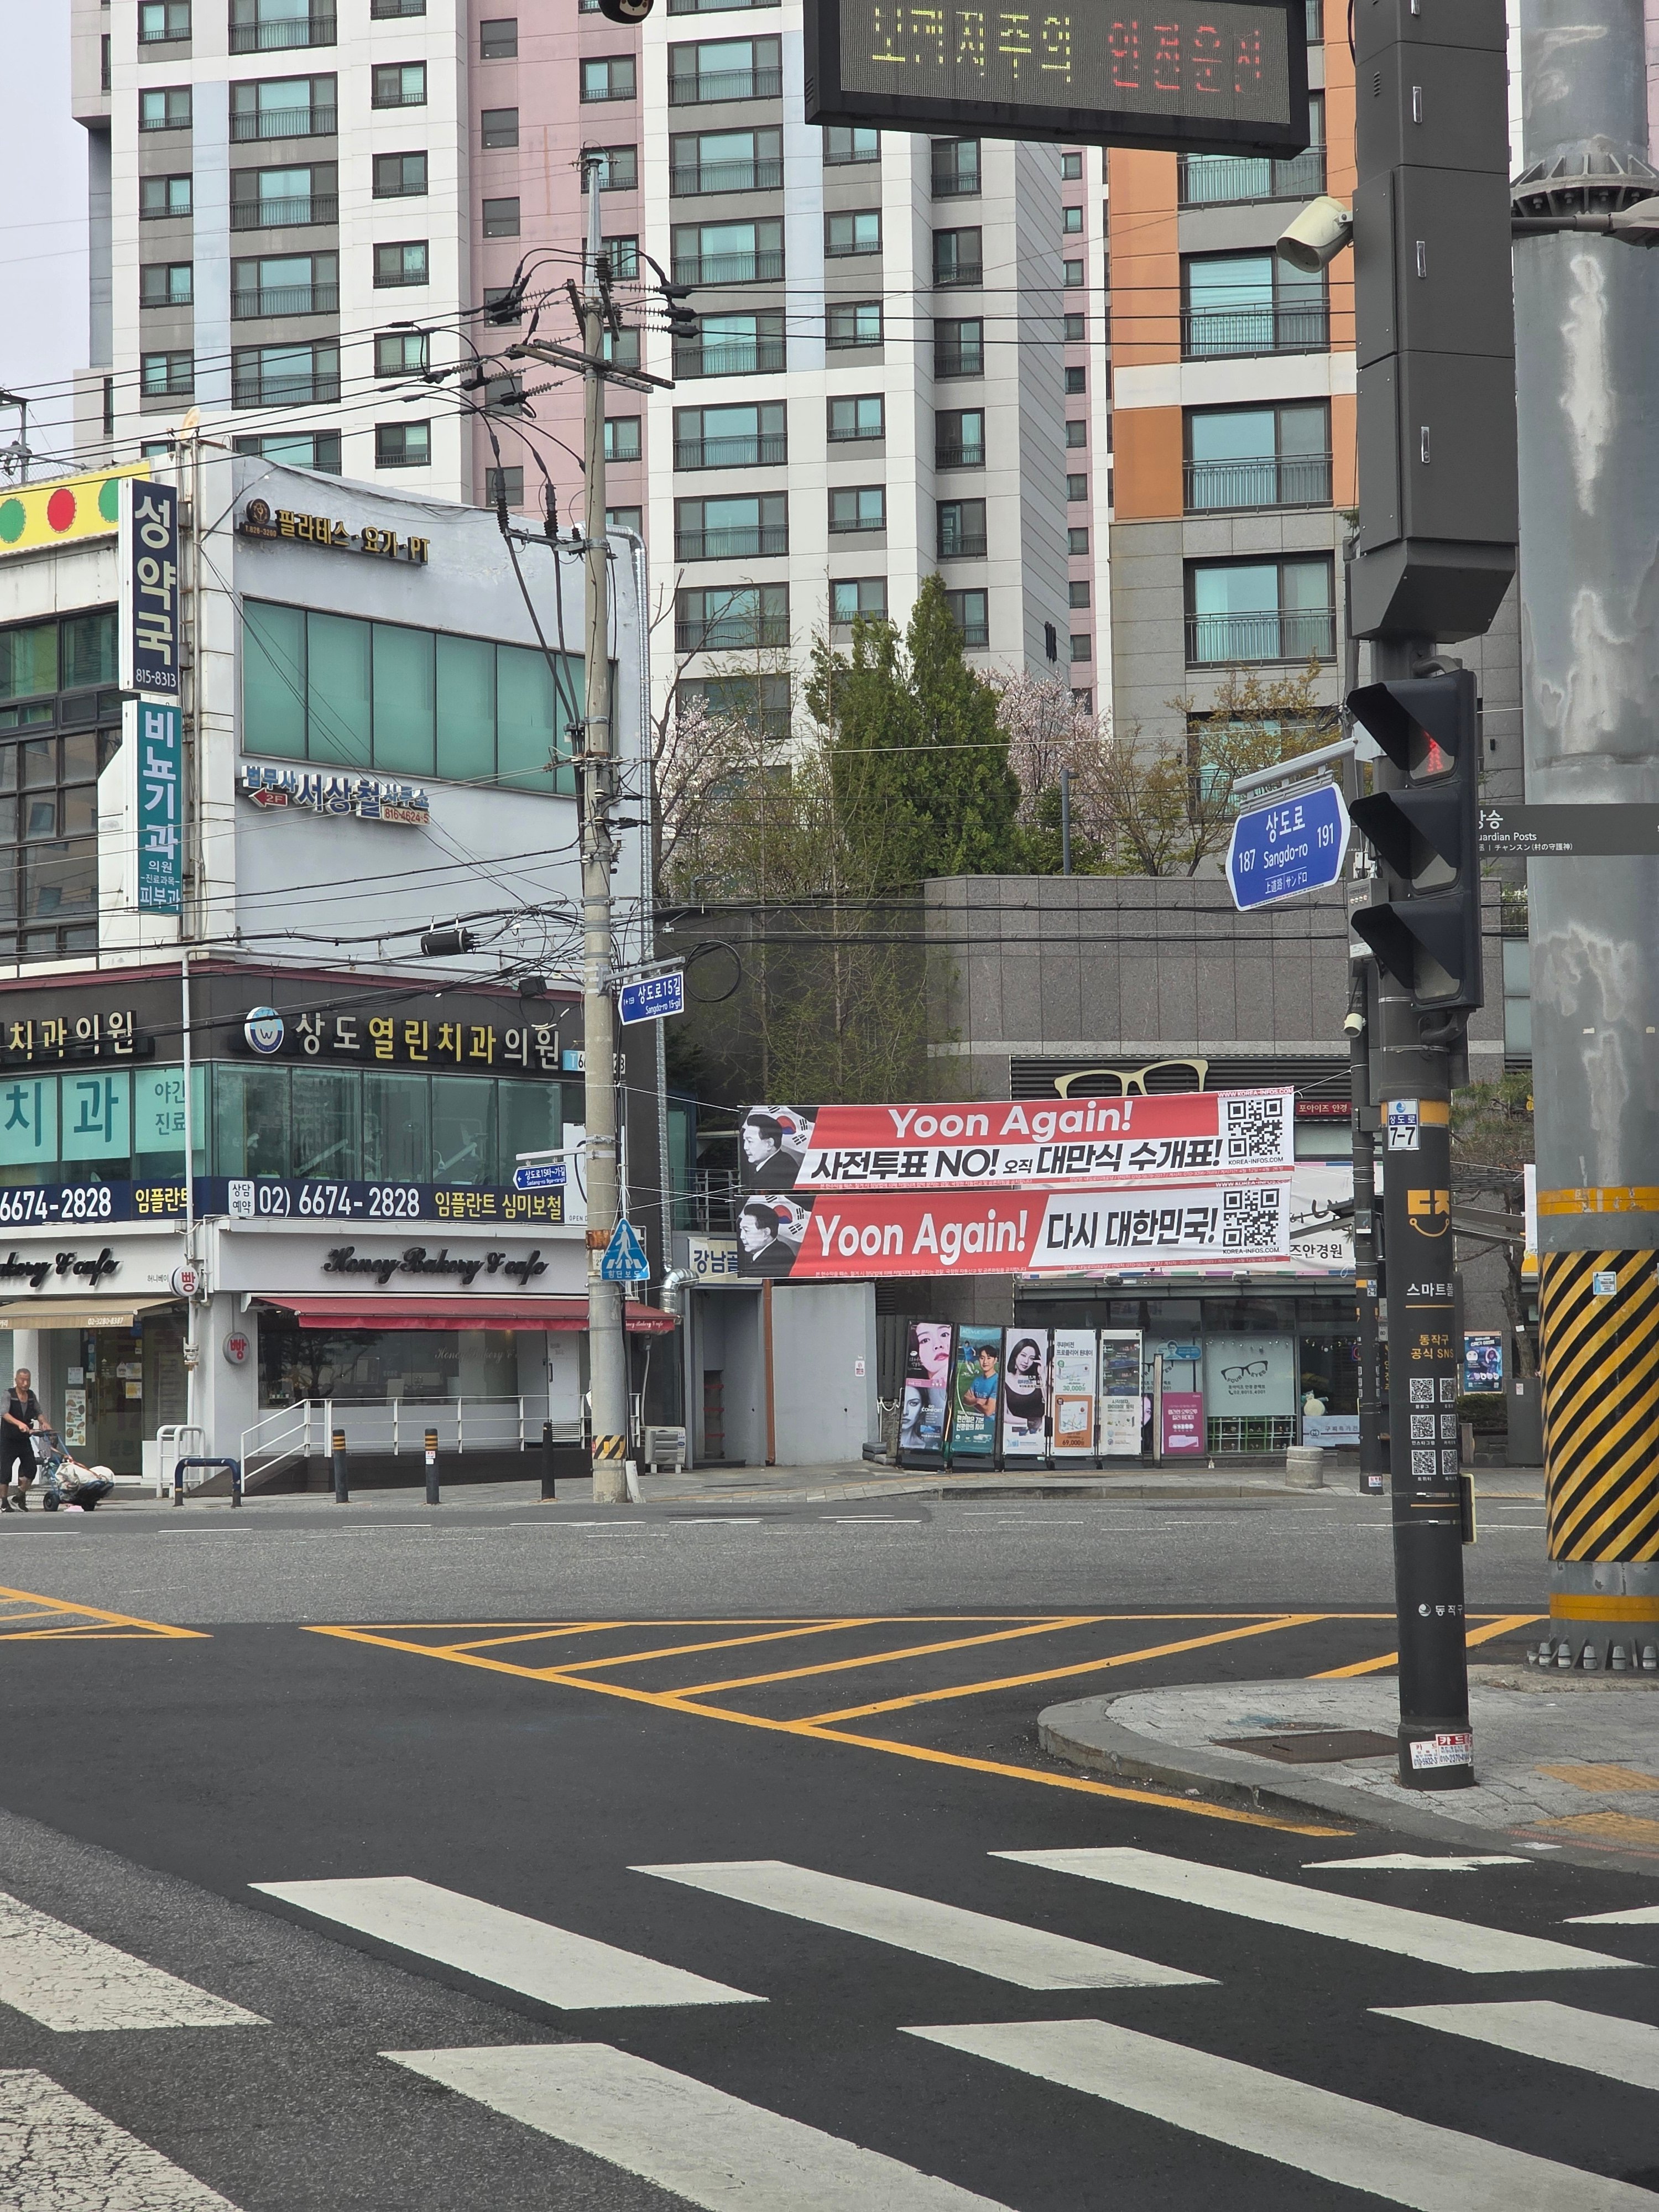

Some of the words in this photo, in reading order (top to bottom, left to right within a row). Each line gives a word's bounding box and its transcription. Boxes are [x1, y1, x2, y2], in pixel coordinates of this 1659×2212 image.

[279, 509, 351, 547] 필라테스
[364, 526, 398, 558] 요가
[410, 536, 430, 563] PT
[134, 495, 176, 665] 성약국
[135, 668, 176, 687] 815-8313
[143, 711, 179, 860] 비뇨기과
[242, 765, 296, 793] 법무사
[294, 774, 381, 818] 서상철
[265, 794, 283, 803] 2F
[1265, 805, 1306, 843] 상도로
[1317, 822, 1334, 848] 191
[1513, 832, 1537, 841] Posts
[148, 860, 173, 873] 의원
[1239, 848, 1256, 873] 187
[1263, 842, 1308, 869] Sangdo-ro
[1265, 878, 1283, 894] 上道路
[140, 886, 181, 911] 피부과
[638, 975, 681, 1005] 상도로15길
[645, 1003, 668, 1015] Sangdo-ro
[9, 1011, 133, 1060] 치과의원
[1332, 1105, 1348, 1113] 안경
[1389, 1115, 1416, 1124] 상도로
[155, 1113, 186, 1136] 진료
[888, 1108, 989, 1139] Yoon
[999, 1100, 1133, 1143] Again!
[1390, 1126, 1416, 1146] 7-7
[810, 1150, 929, 1180] 사전투표
[935, 1148, 1000, 1178] NO!
[1002, 1159, 1034, 1175] 오직
[1036, 1141, 1124, 1175] 대만식
[1128, 1138, 1224, 1171] 수개표!
[1228, 1156, 1284, 1165] KOREA-INFOS.COM
[135, 1187, 187, 1213] 임플란트
[232, 1183, 252, 1198] 상담
[0, 1187, 111, 1221] 6674-2828
[232, 1200, 252, 1214] 예약
[259, 1186, 291, 1217] 02)
[435, 1192, 497, 1218] 임플란트
[501, 1194, 562, 1220] 심미보철
[815, 1214, 904, 1258] Yoon
[911, 1208, 1028, 1266] Again!
[1046, 1212, 1096, 1250] 다시
[1104, 1207, 1219, 1248] 대한민국!
[1222, 1246, 1280, 1255] KOREA-INFOS.COM
[322, 1245, 401, 1285] Honey
[400, 1246, 486, 1285] Bakery
[608, 1270, 641, 1279] 횡단보도
[181, 1271, 196, 1292] 빵
[1406, 1282, 1454, 1297] 스마트폴
[229, 1338, 247, 1360] 빵
[1419, 1334, 1449, 1345] 동작구
[1411, 1348, 1433, 1360] 공식
[1437, 1348, 1454, 1358] SNS
[1227, 1375, 1243, 1384] FOUR
[1434, 1604, 1463, 1616] 동작구
[1439, 1735, 1464, 1745] 카드
